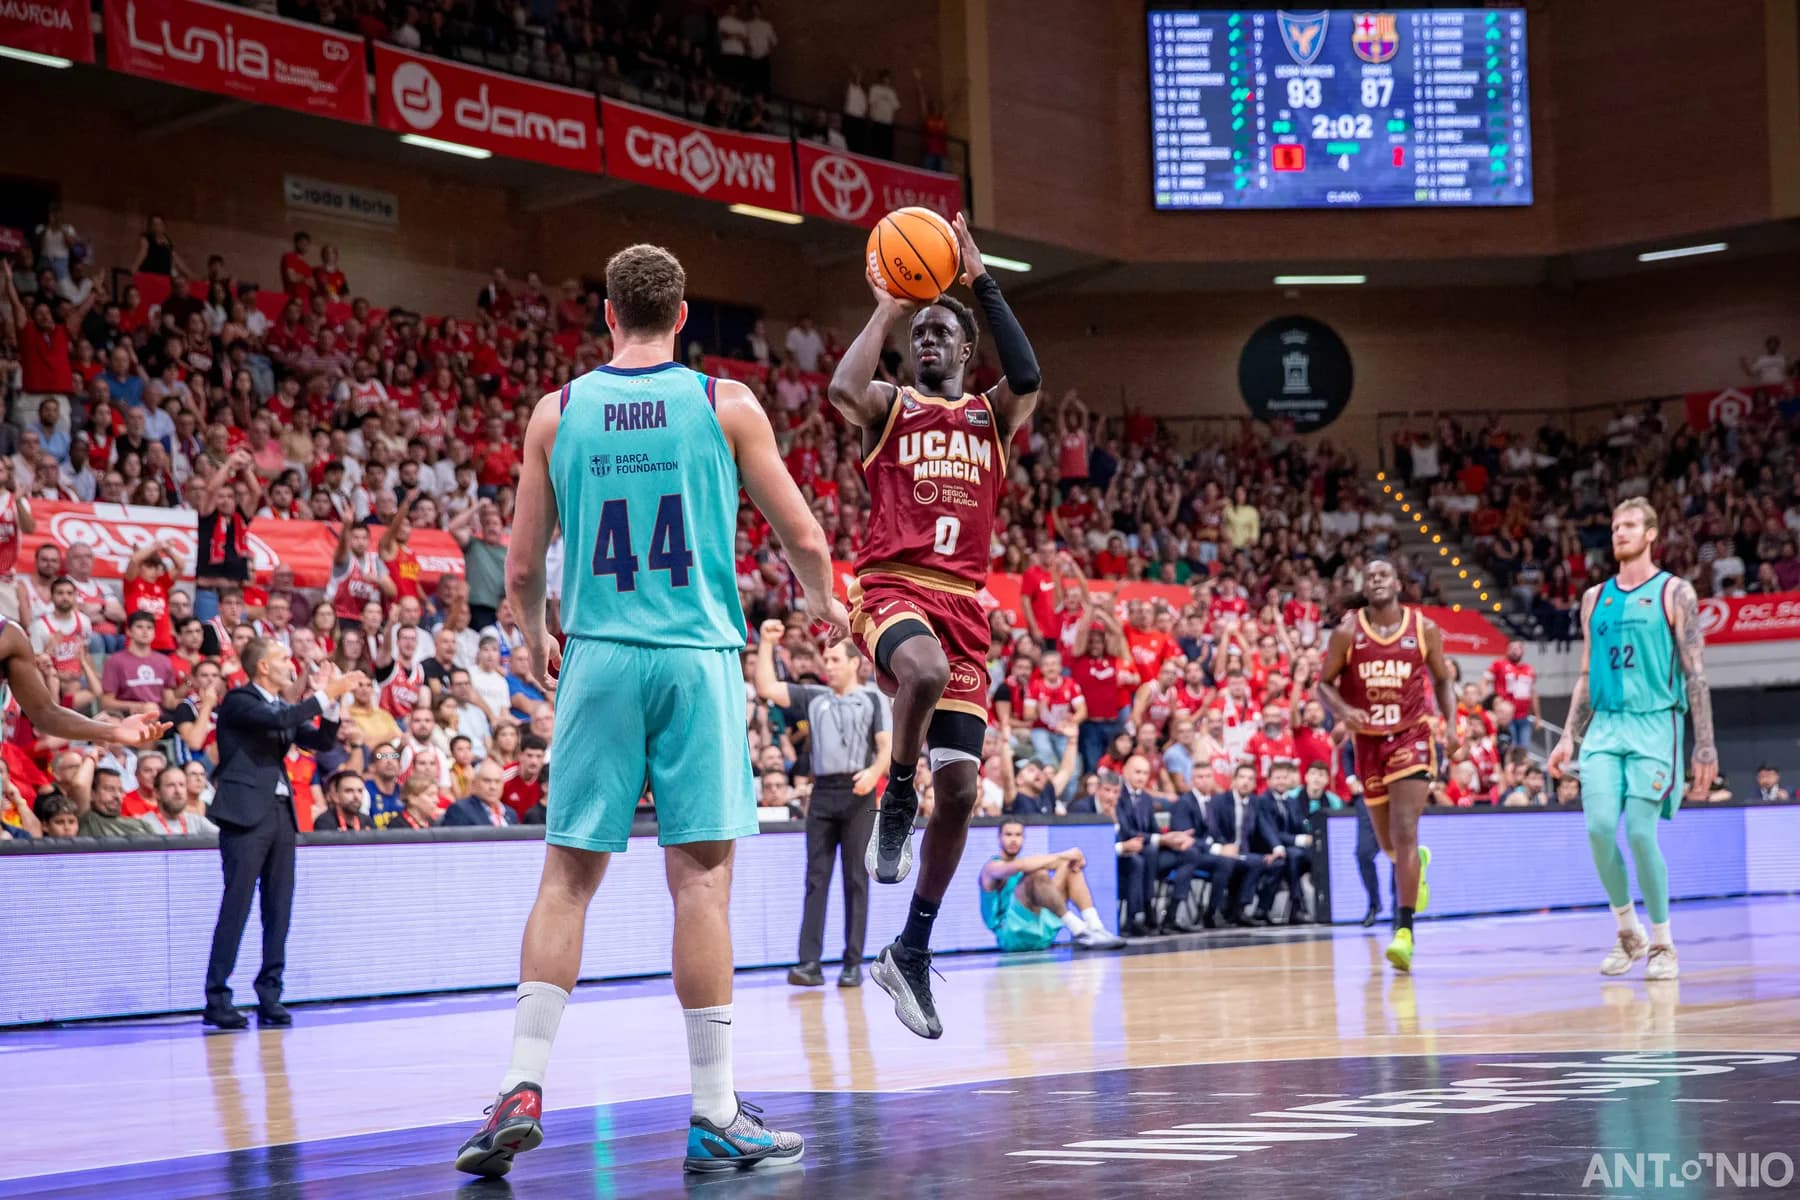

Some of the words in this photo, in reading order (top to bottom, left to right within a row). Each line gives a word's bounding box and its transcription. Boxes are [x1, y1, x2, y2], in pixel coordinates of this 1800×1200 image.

[1287, 78, 1322, 108] 93
[1361, 77, 1394, 108] 87
[1312, 114, 1374, 140] 2:02
[894, 257, 913, 281] acb
[604, 400, 667, 432] PARRA
[616, 453, 649, 464] BARÇA
[899, 430, 991, 473] UCAM
[616, 461, 679, 475] FOUNDATION
[914, 460, 981, 485] MURCIA
[942, 495, 953, 503] DE
[953, 497, 978, 508] MURCIA
[592, 494, 694, 593] 44
[933, 516, 961, 556] 0
[1358, 659, 1412, 680] UCAM
[1609, 645, 1635, 670] 22
[1370, 703, 1401, 726] 20
